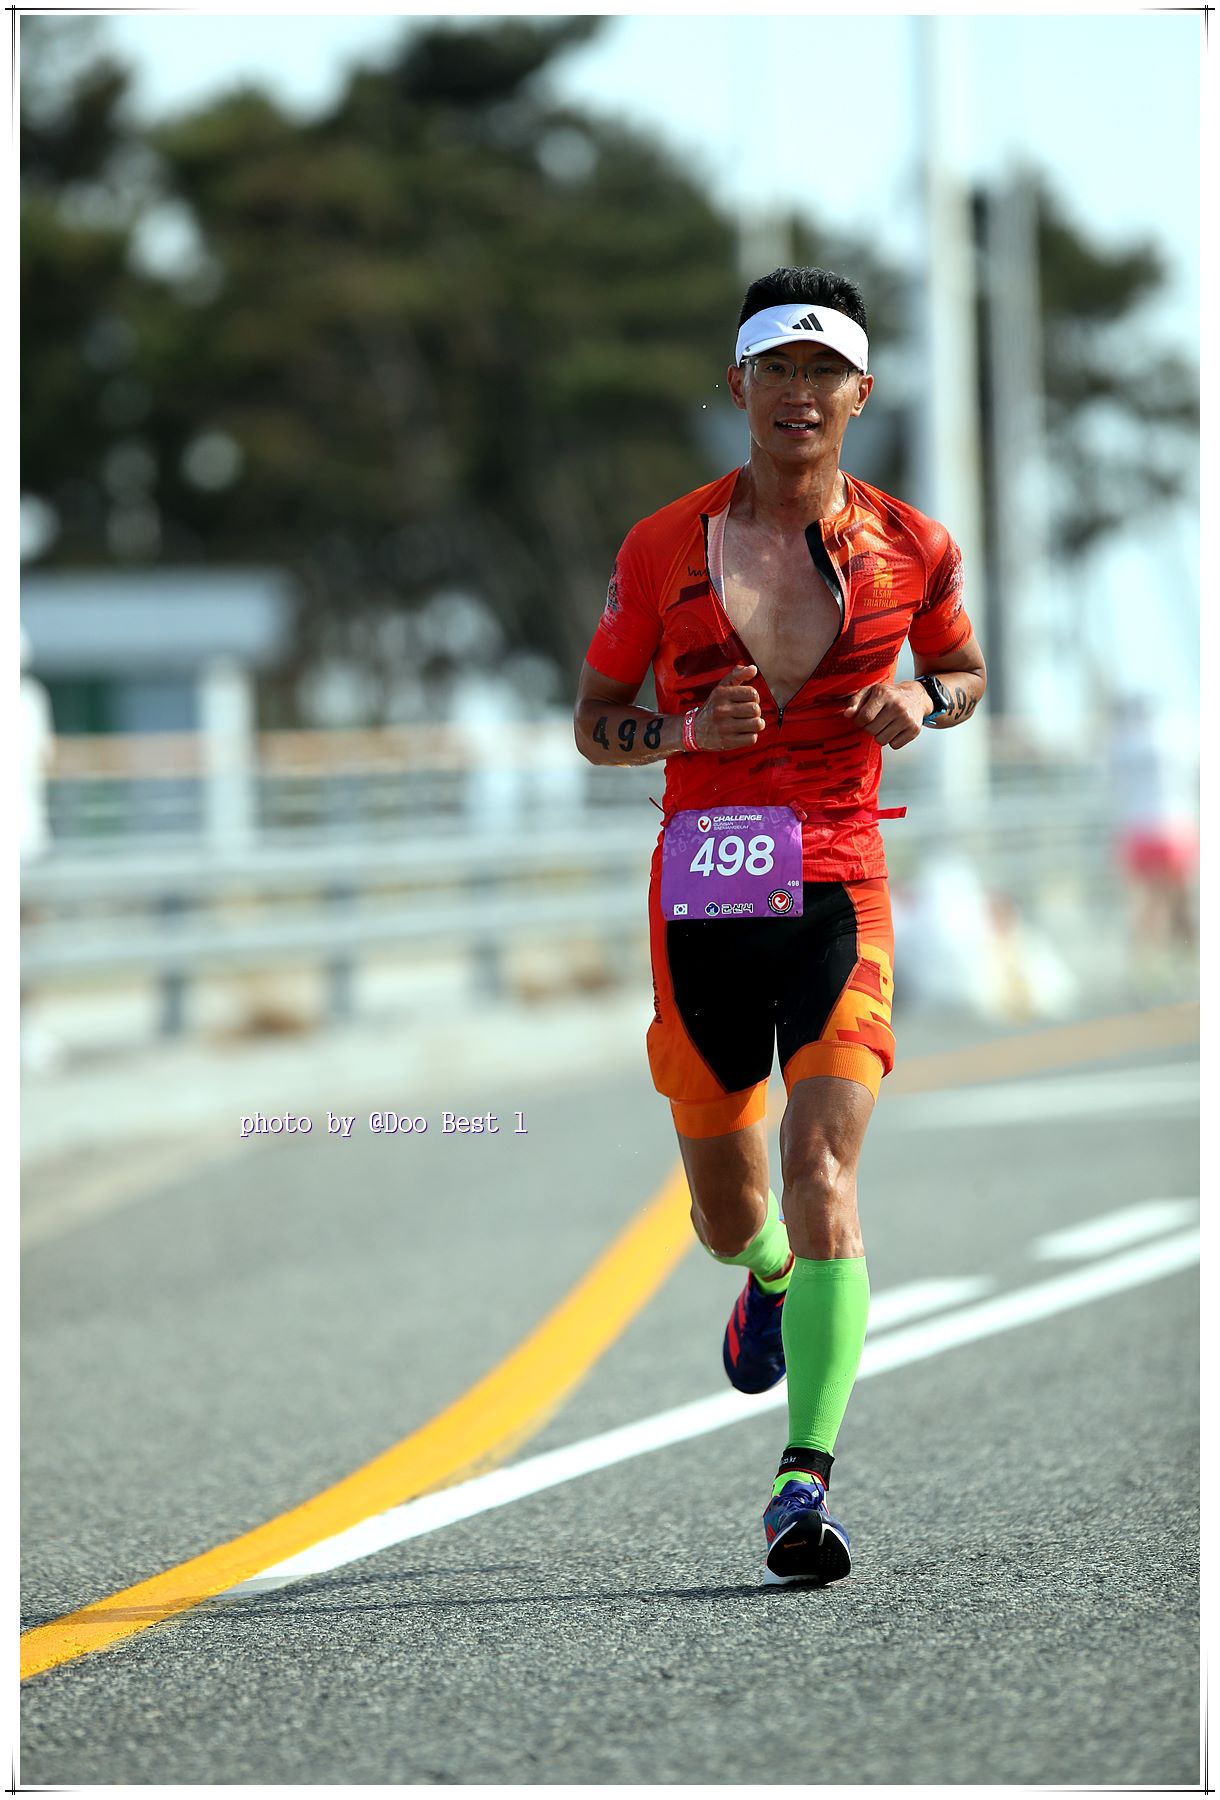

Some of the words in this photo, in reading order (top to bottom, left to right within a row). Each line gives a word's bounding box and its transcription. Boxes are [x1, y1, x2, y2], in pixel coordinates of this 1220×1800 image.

[592, 716, 664, 752] 498
[713, 814, 762, 822] CHALLENGE
[689, 834, 775, 877] 498
[721, 903, 754, 914] 군산시
